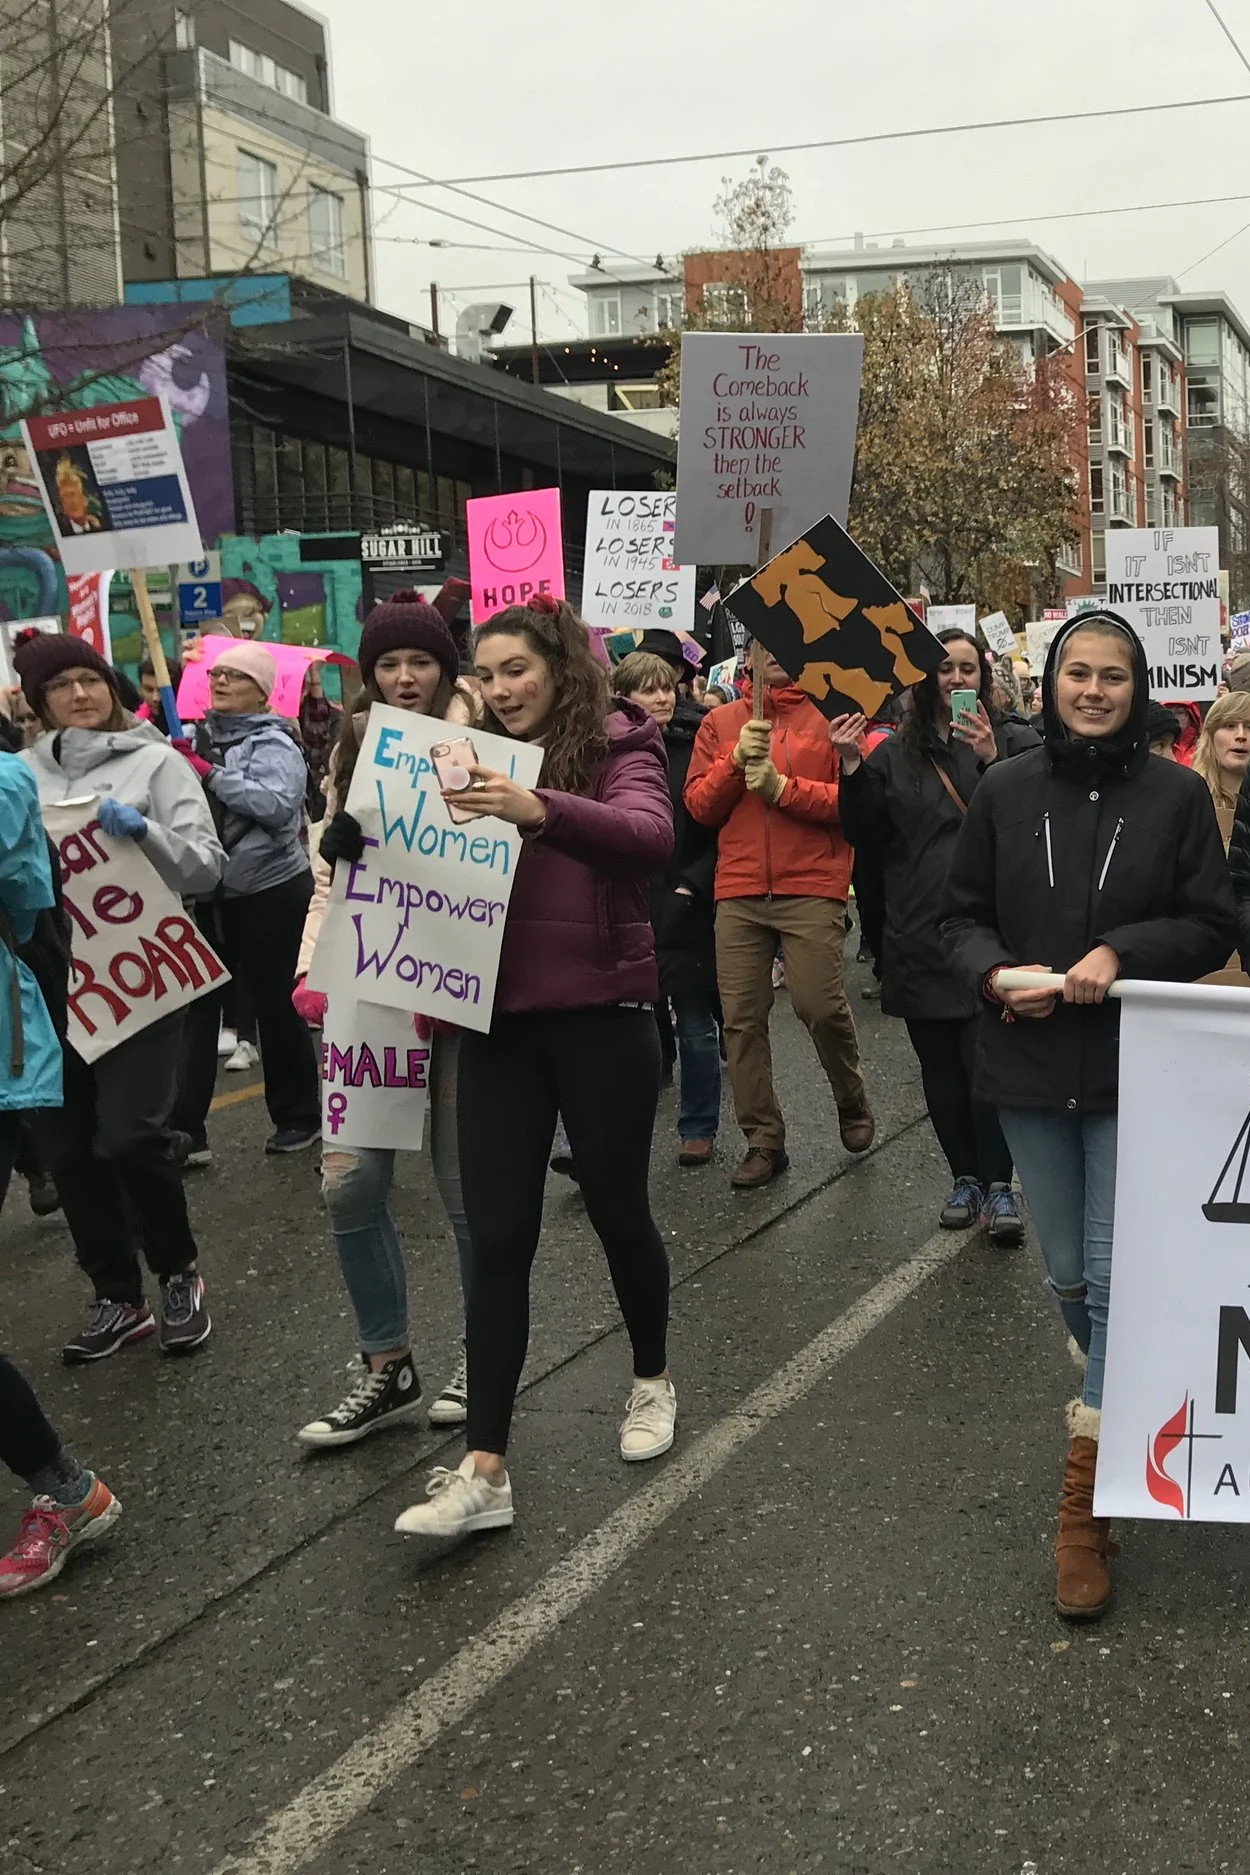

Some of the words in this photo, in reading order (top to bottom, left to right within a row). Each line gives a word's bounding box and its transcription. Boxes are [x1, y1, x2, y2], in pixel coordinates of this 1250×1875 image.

[738, 345, 781, 371] The
[713, 372, 810, 398] Comeback
[717, 402, 732, 422] is
[739, 401, 798, 425] always
[703, 425, 806, 449] STRONGER
[755, 453, 783, 474] the
[716, 477, 783, 499] setback
[606, 517, 620, 530] IN
[627, 519, 657, 533] 1865
[361, 539, 406, 558] SUGAR
[411, 537, 442, 556] HILL
[1153, 530, 1174, 551] IF
[603, 556, 620, 568] IN
[625, 557, 657, 570] 1945
[1125, 556, 1146, 577] IT
[193, 586, 208, 608] 2
[483, 579, 553, 609] HOPE
[595, 580, 680, 604] LOSERS
[1109, 577, 1220, 604] INTERSECTIONAL
[601, 602, 617, 614] IN
[623, 602, 653, 616] 2018
[1140, 605, 1192, 627] THEN
[374, 778, 510, 876] Women
[345, 837, 505, 929] Empower
[351, 913, 481, 1005] Women
[67, 915, 226, 1037] ROAR
[1214, 1464, 1241, 1496] A
